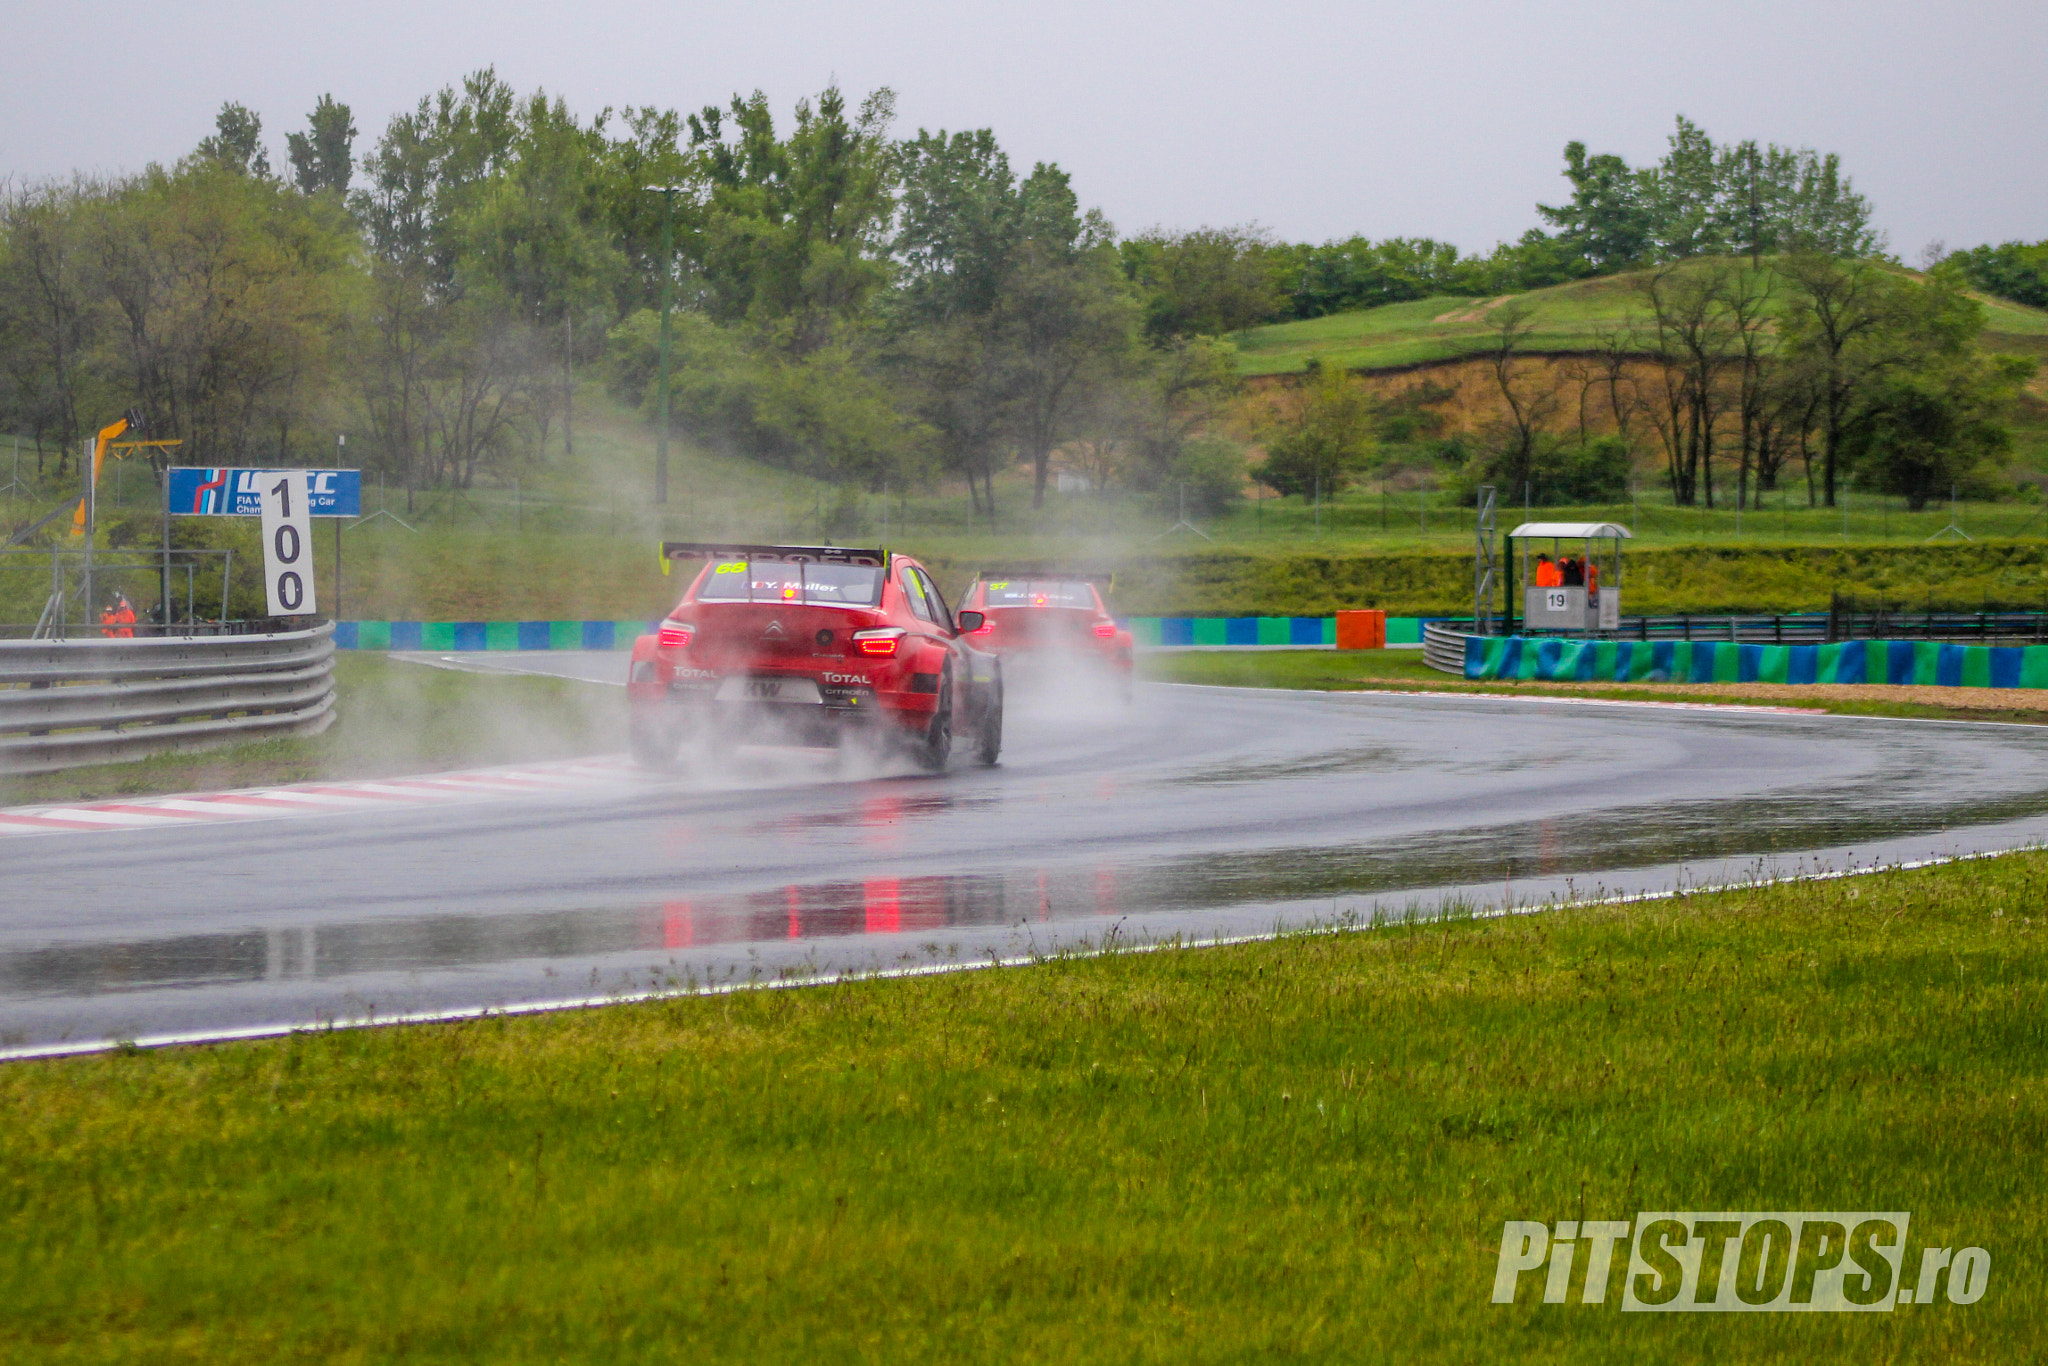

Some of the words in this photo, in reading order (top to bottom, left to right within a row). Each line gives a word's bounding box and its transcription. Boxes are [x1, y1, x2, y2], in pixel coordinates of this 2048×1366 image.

[236, 496, 253, 505] FIA
[318, 497, 335, 506] Car
[271, 478, 304, 610] 100
[715, 561, 748, 574] 68
[765, 581, 778, 589] Y.
[989, 582, 1009, 591] 37
[1548, 594, 1565, 607] 19
[673, 666, 718, 679] TOTAL
[822, 671, 871, 684] TOTAL
